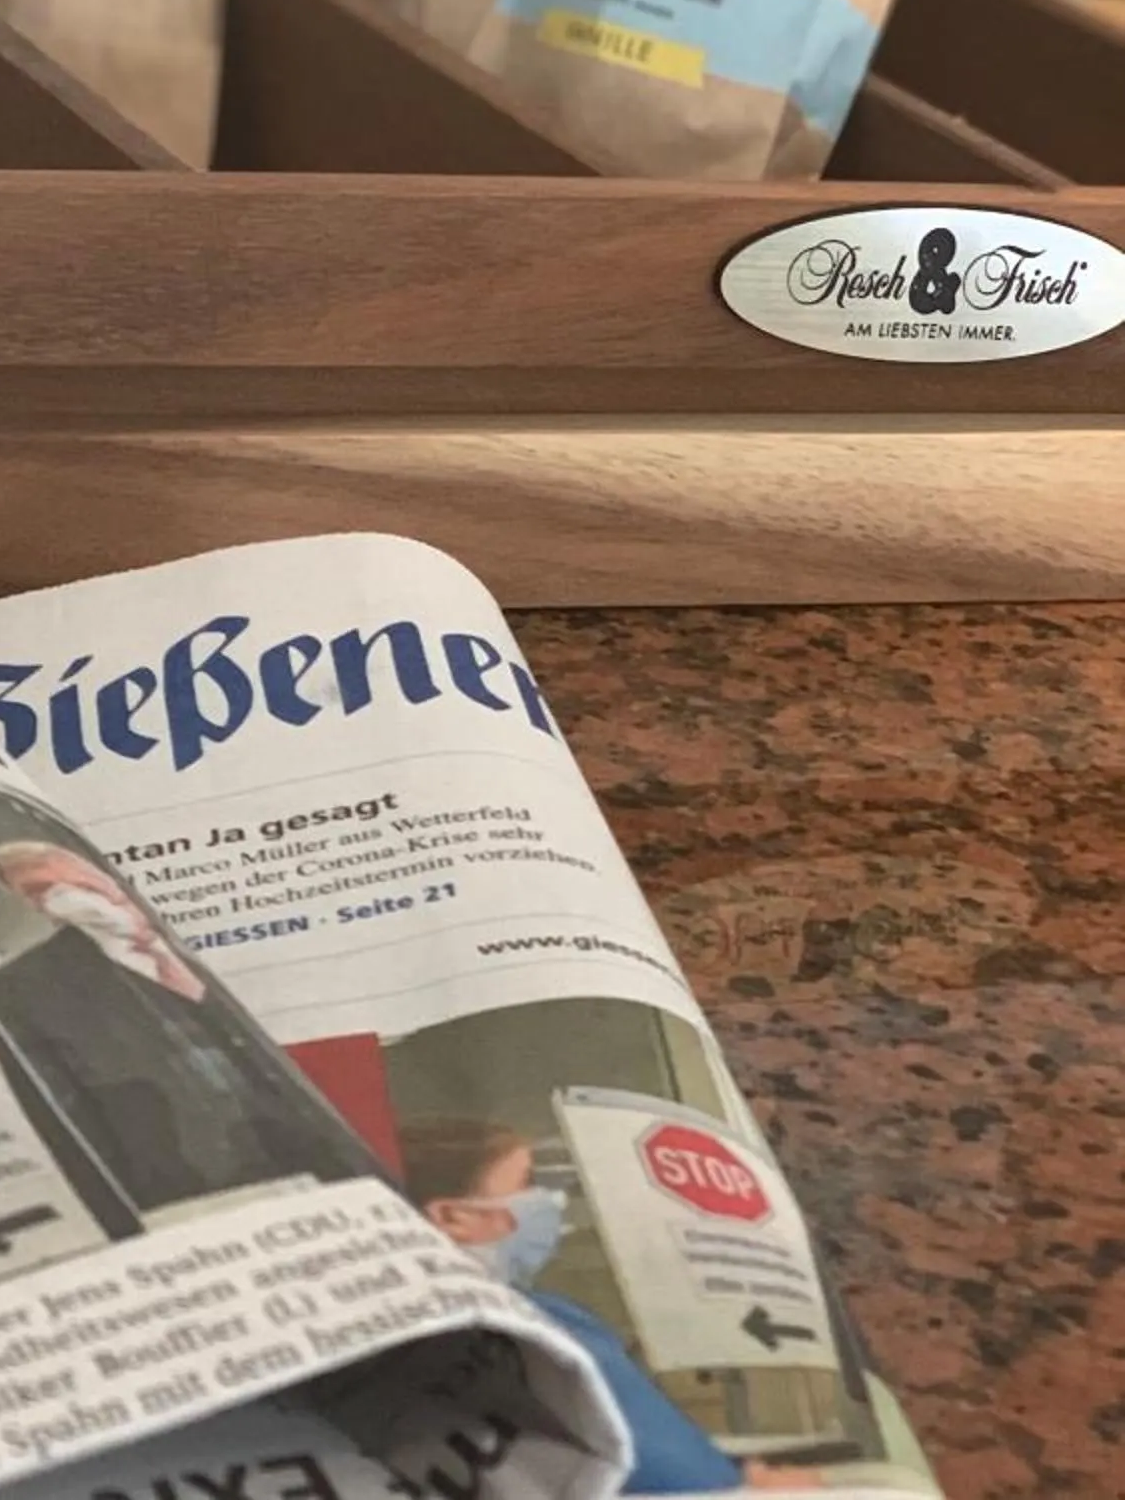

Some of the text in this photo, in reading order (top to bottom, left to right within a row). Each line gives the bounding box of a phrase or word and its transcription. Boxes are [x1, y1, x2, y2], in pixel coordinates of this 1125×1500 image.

[963, 245, 1078, 310] Frisch
[843, 323, 872, 338] AM
[878, 322, 952, 340] LIEBSTEN
[144, 858, 232, 886] Marco
[239, 836, 331, 867] Müller
[337, 826, 383, 847] aus
[390, 805, 532, 834] Wetterfeld
[205, 827, 246, 848] Ja
[259, 792, 400, 842] gesagt
[149, 877, 237, 908] wegen
[245, 869, 288, 889] der
[296, 830, 480, 879] Corona-Krise
[487, 825, 545, 843] sehr
[230, 856, 455, 914] Hochzeitstermin
[184, 882, 457, 952] GIESSEN Seite 21
[654, 1146, 755, 1202] STOP
